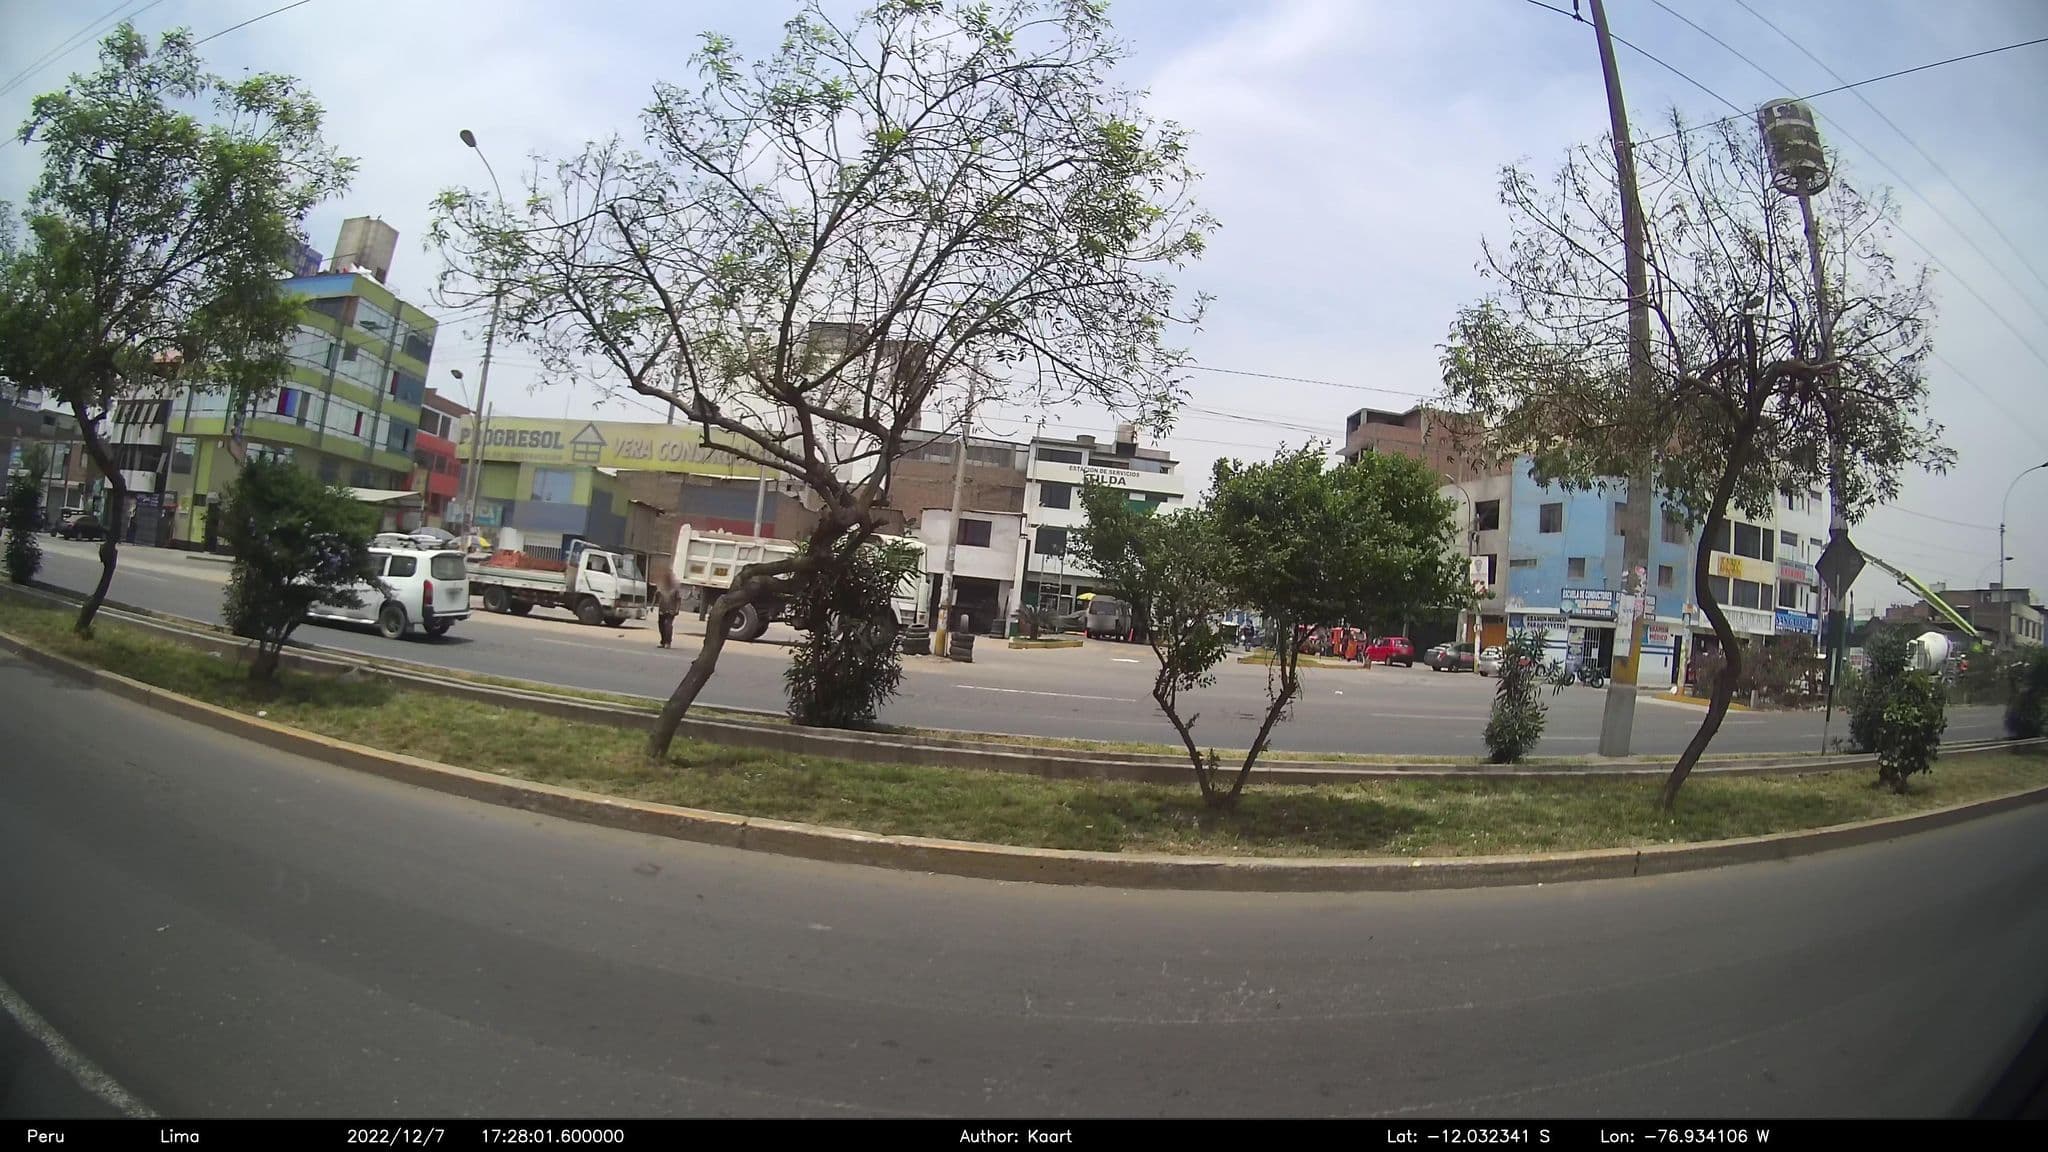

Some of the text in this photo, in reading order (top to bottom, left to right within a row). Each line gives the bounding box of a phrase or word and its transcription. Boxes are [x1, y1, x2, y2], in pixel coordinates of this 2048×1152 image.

[459, 428, 565, 449] POGRESOL
[614, 436, 653, 460] VERA
[1109, 469, 1140, 478] SERVICIOS
